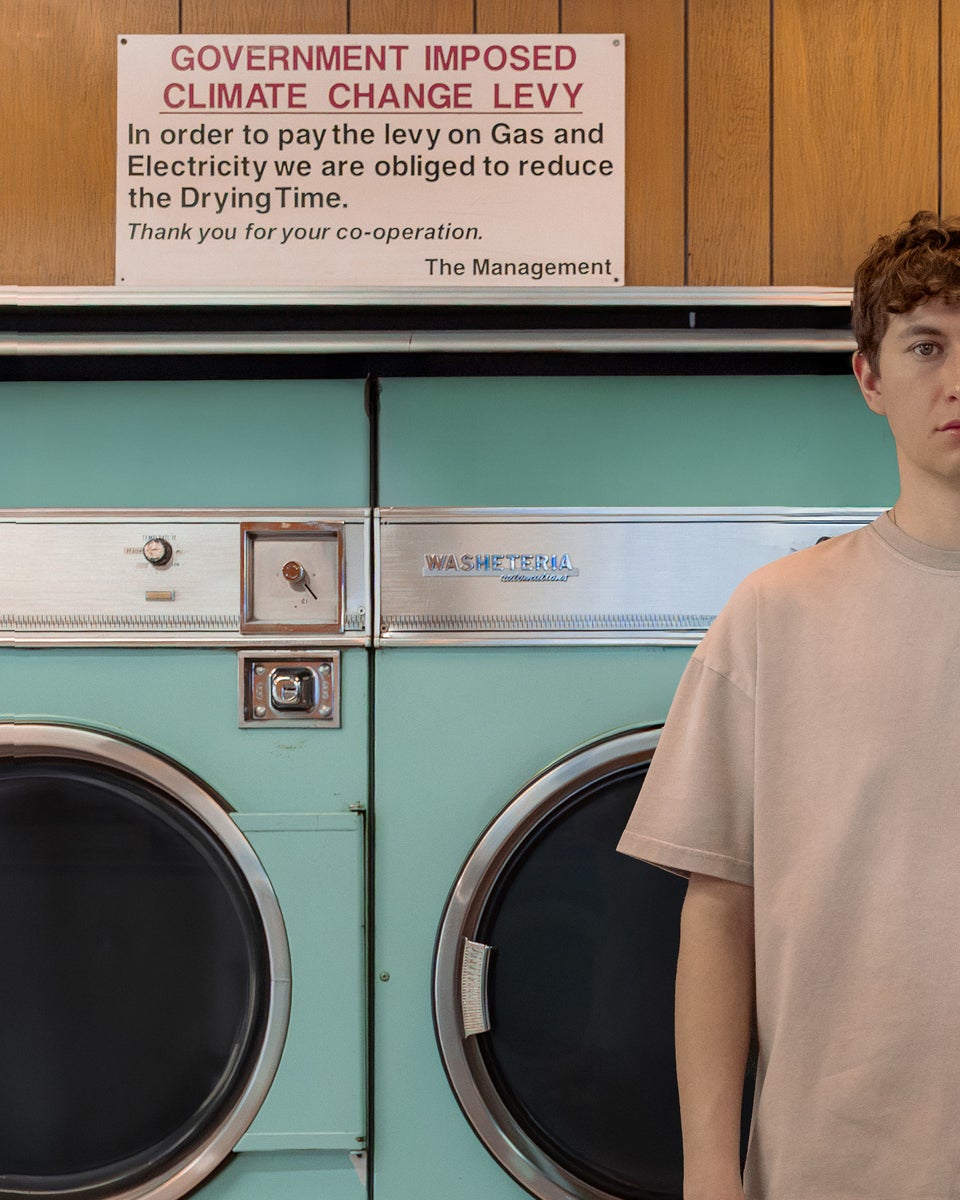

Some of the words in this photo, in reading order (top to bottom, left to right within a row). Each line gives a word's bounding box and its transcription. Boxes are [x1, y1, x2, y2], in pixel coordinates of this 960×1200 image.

[171, 44, 409, 72] GOVERNMENT
[425, 44, 577, 72] IMPOSED
[163, 82, 307, 109] CLIMATE
[328, 82, 473, 110] CHANGE
[493, 82, 584, 109] LEVY
[128, 123, 150, 145] In
[160, 123, 234, 145] order
[242, 124, 269, 145] to
[278, 128, 326, 149] pay
[332, 122, 375, 145] the
[384, 122, 441, 149] levy
[447, 128, 481, 145] on
[490, 122, 544, 145] Gas
[553, 122, 604, 145] and
[128, 154, 267, 183] Electricity
[273, 160, 312, 177] we
[321, 159, 365, 177] are
[374, 154, 475, 183] obliged
[482, 155, 510, 177] to
[519, 154, 614, 177] reduce
[128, 186, 172, 209] the
[181, 186, 270, 213] Drying
[274, 186, 348, 209] Time.
[128, 222, 192, 240] Thank
[197, 227, 237, 245] you
[245, 222, 278, 240] for
[281, 227, 331, 245] your
[336, 222, 483, 245] co-operation.
[424, 258, 466, 276] The
[472, 258, 613, 281] Management
[424, 553, 573, 571] WASHETERIA
